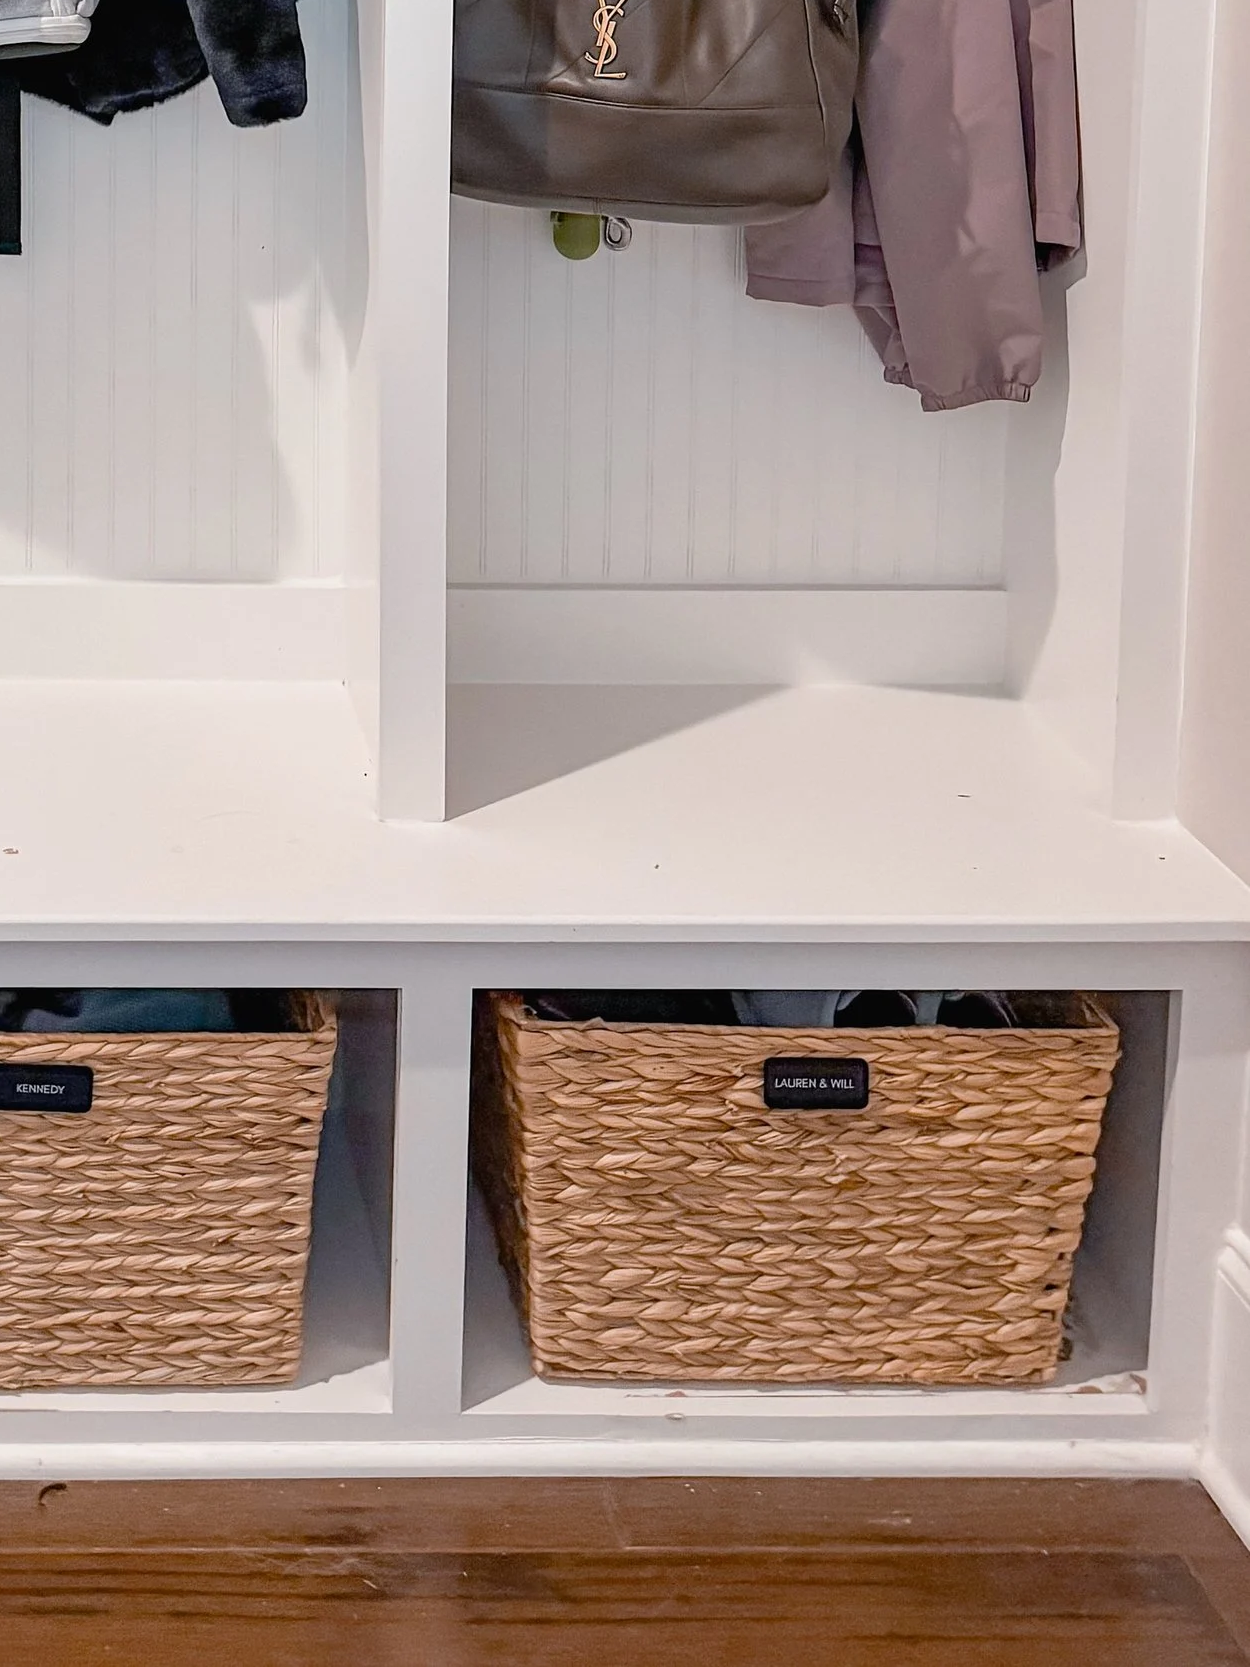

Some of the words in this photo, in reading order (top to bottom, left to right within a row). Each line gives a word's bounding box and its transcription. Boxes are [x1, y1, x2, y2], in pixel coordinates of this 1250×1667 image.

[15, 1083, 66, 1095] KENNEDY
[774, 1077, 817, 1089] LAUREN
[819, 1078, 828, 1089] &
[830, 1078, 855, 1089] WILL
